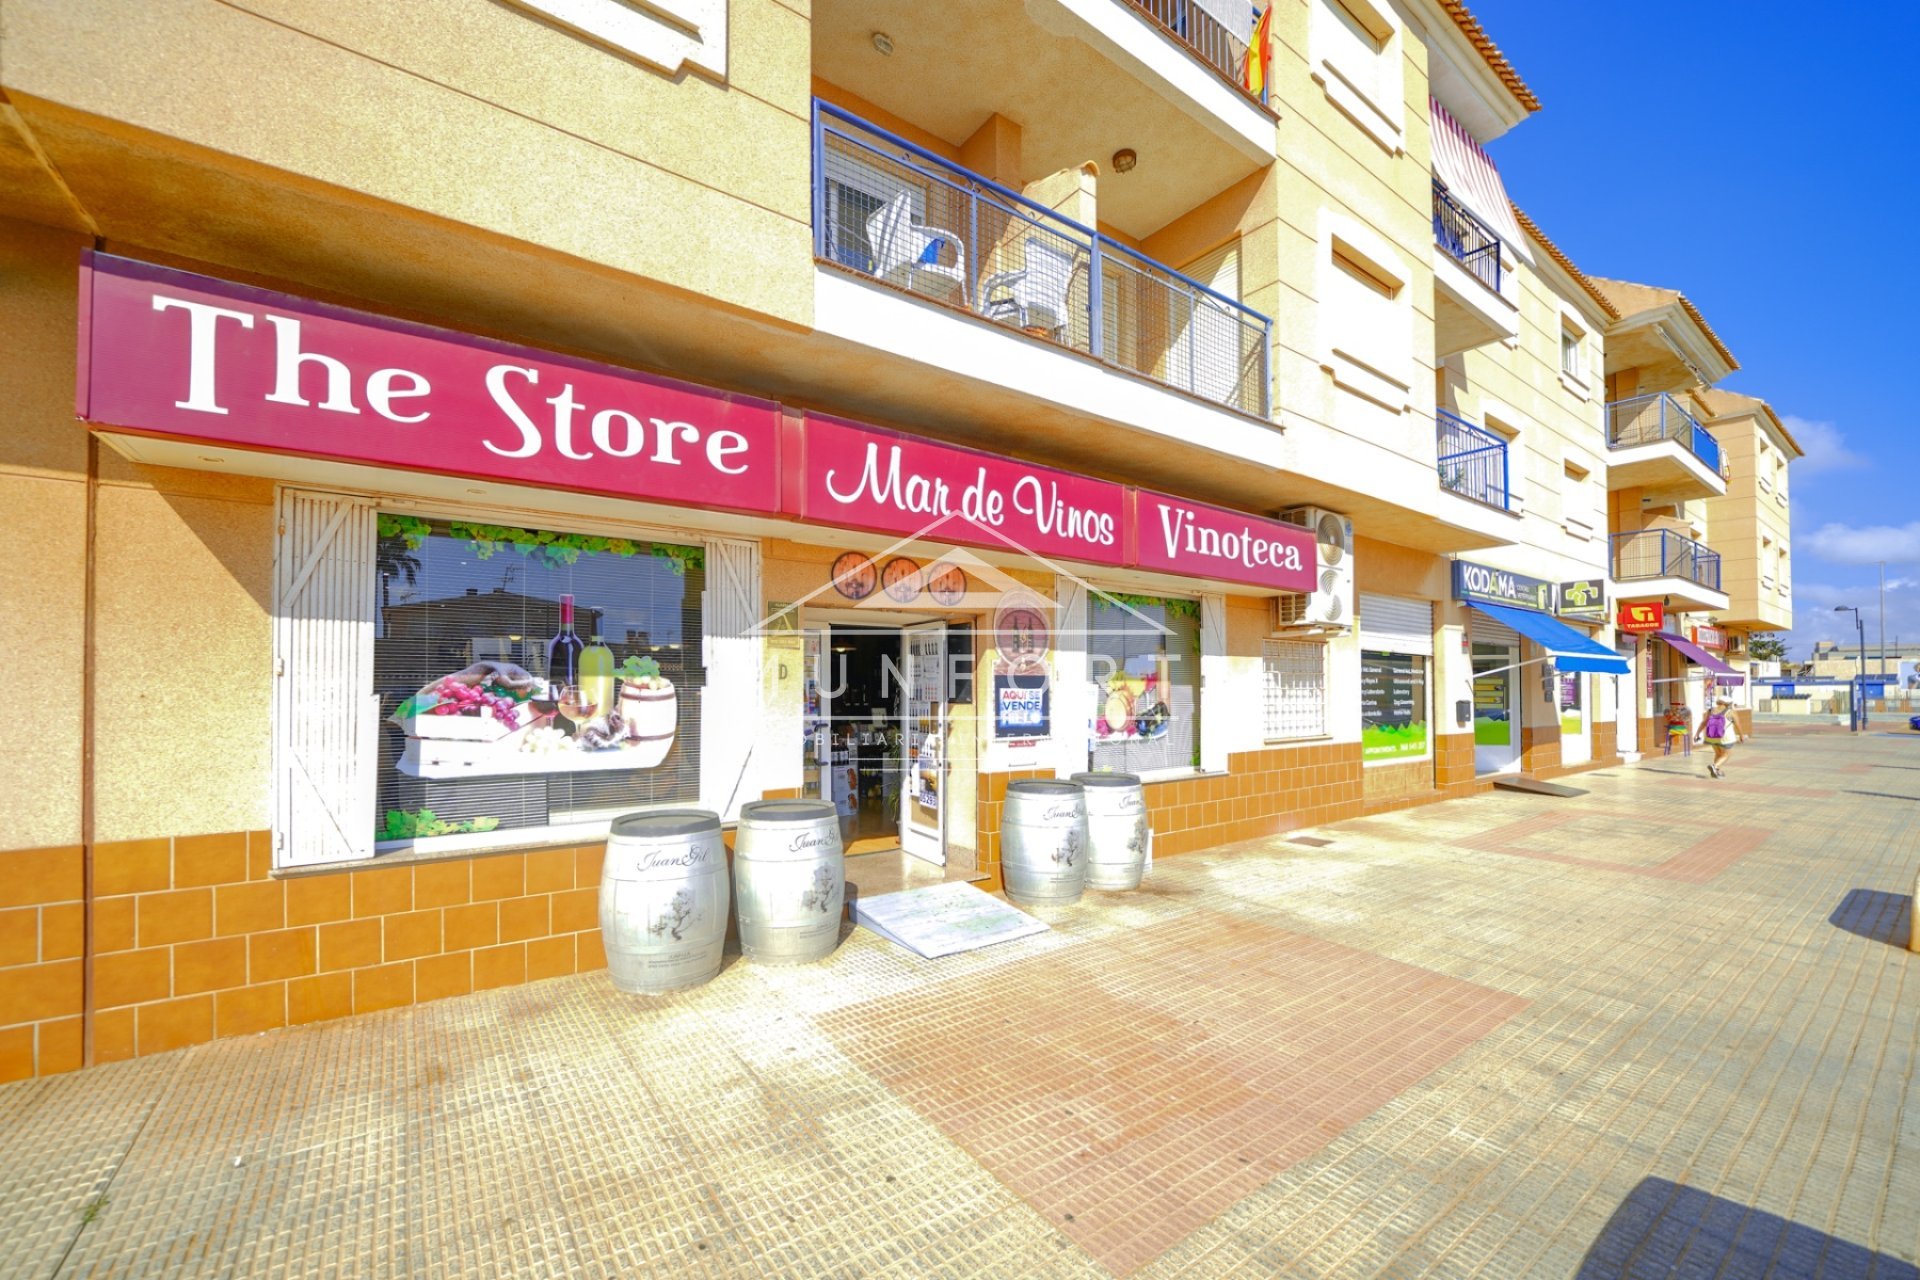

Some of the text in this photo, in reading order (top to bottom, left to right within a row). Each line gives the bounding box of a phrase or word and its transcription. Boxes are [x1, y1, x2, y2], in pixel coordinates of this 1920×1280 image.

[152, 294, 749, 474] The Store
[826, 443, 1115, 546] Mar de Vinos
[1157, 504, 1304, 572] Vinoteca
[1463, 564, 1517, 599] KODAMA
[1002, 701, 1041, 711] VENDE
[789, 832, 824, 852] Juan
[637, 850, 680, 871] Juan
